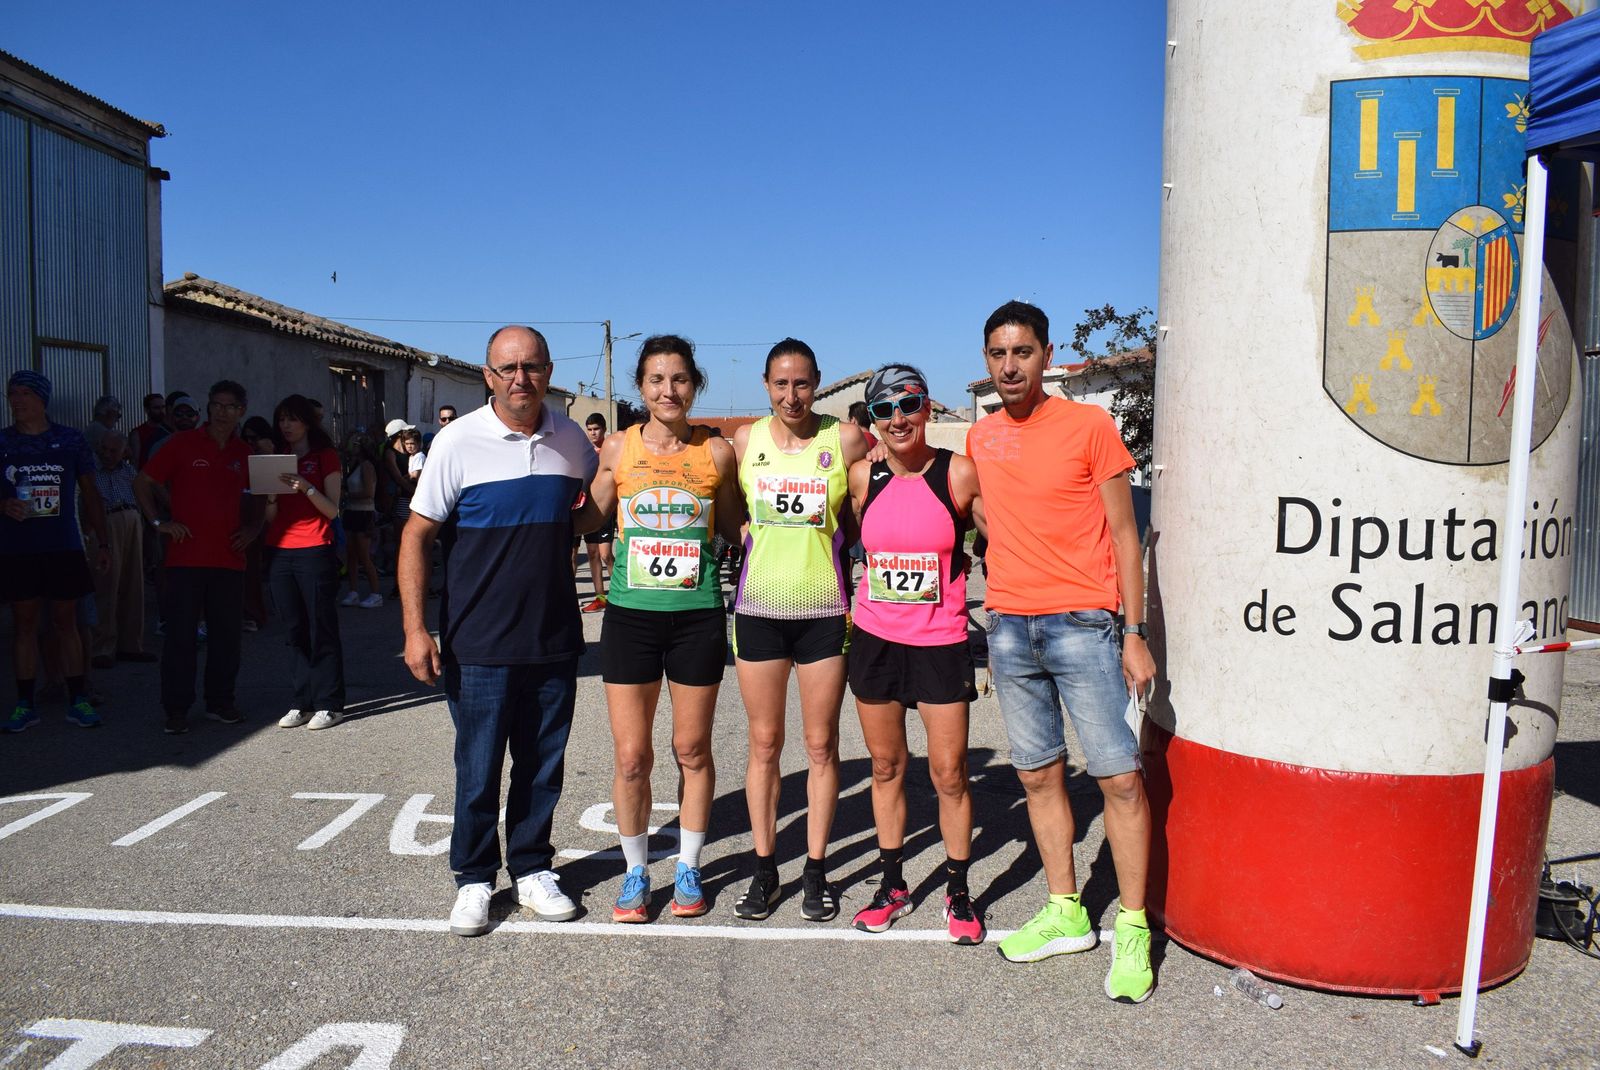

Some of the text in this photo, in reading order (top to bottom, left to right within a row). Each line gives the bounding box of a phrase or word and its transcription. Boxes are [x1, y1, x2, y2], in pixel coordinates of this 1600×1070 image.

[27, 473, 61, 484] unning
[756, 478, 827, 495] bedunia
[35, 497, 52, 509] 16
[634, 503, 695, 517] ALCER
[776, 493, 804, 514] 56
[1275, 496, 1572, 574] Diputaión
[631, 540, 699, 557] bedunia
[649, 556, 678, 577] 66
[868, 554, 937, 571] bedunia
[882, 570, 924, 591] 127
[1243, 588, 1297, 636] de
